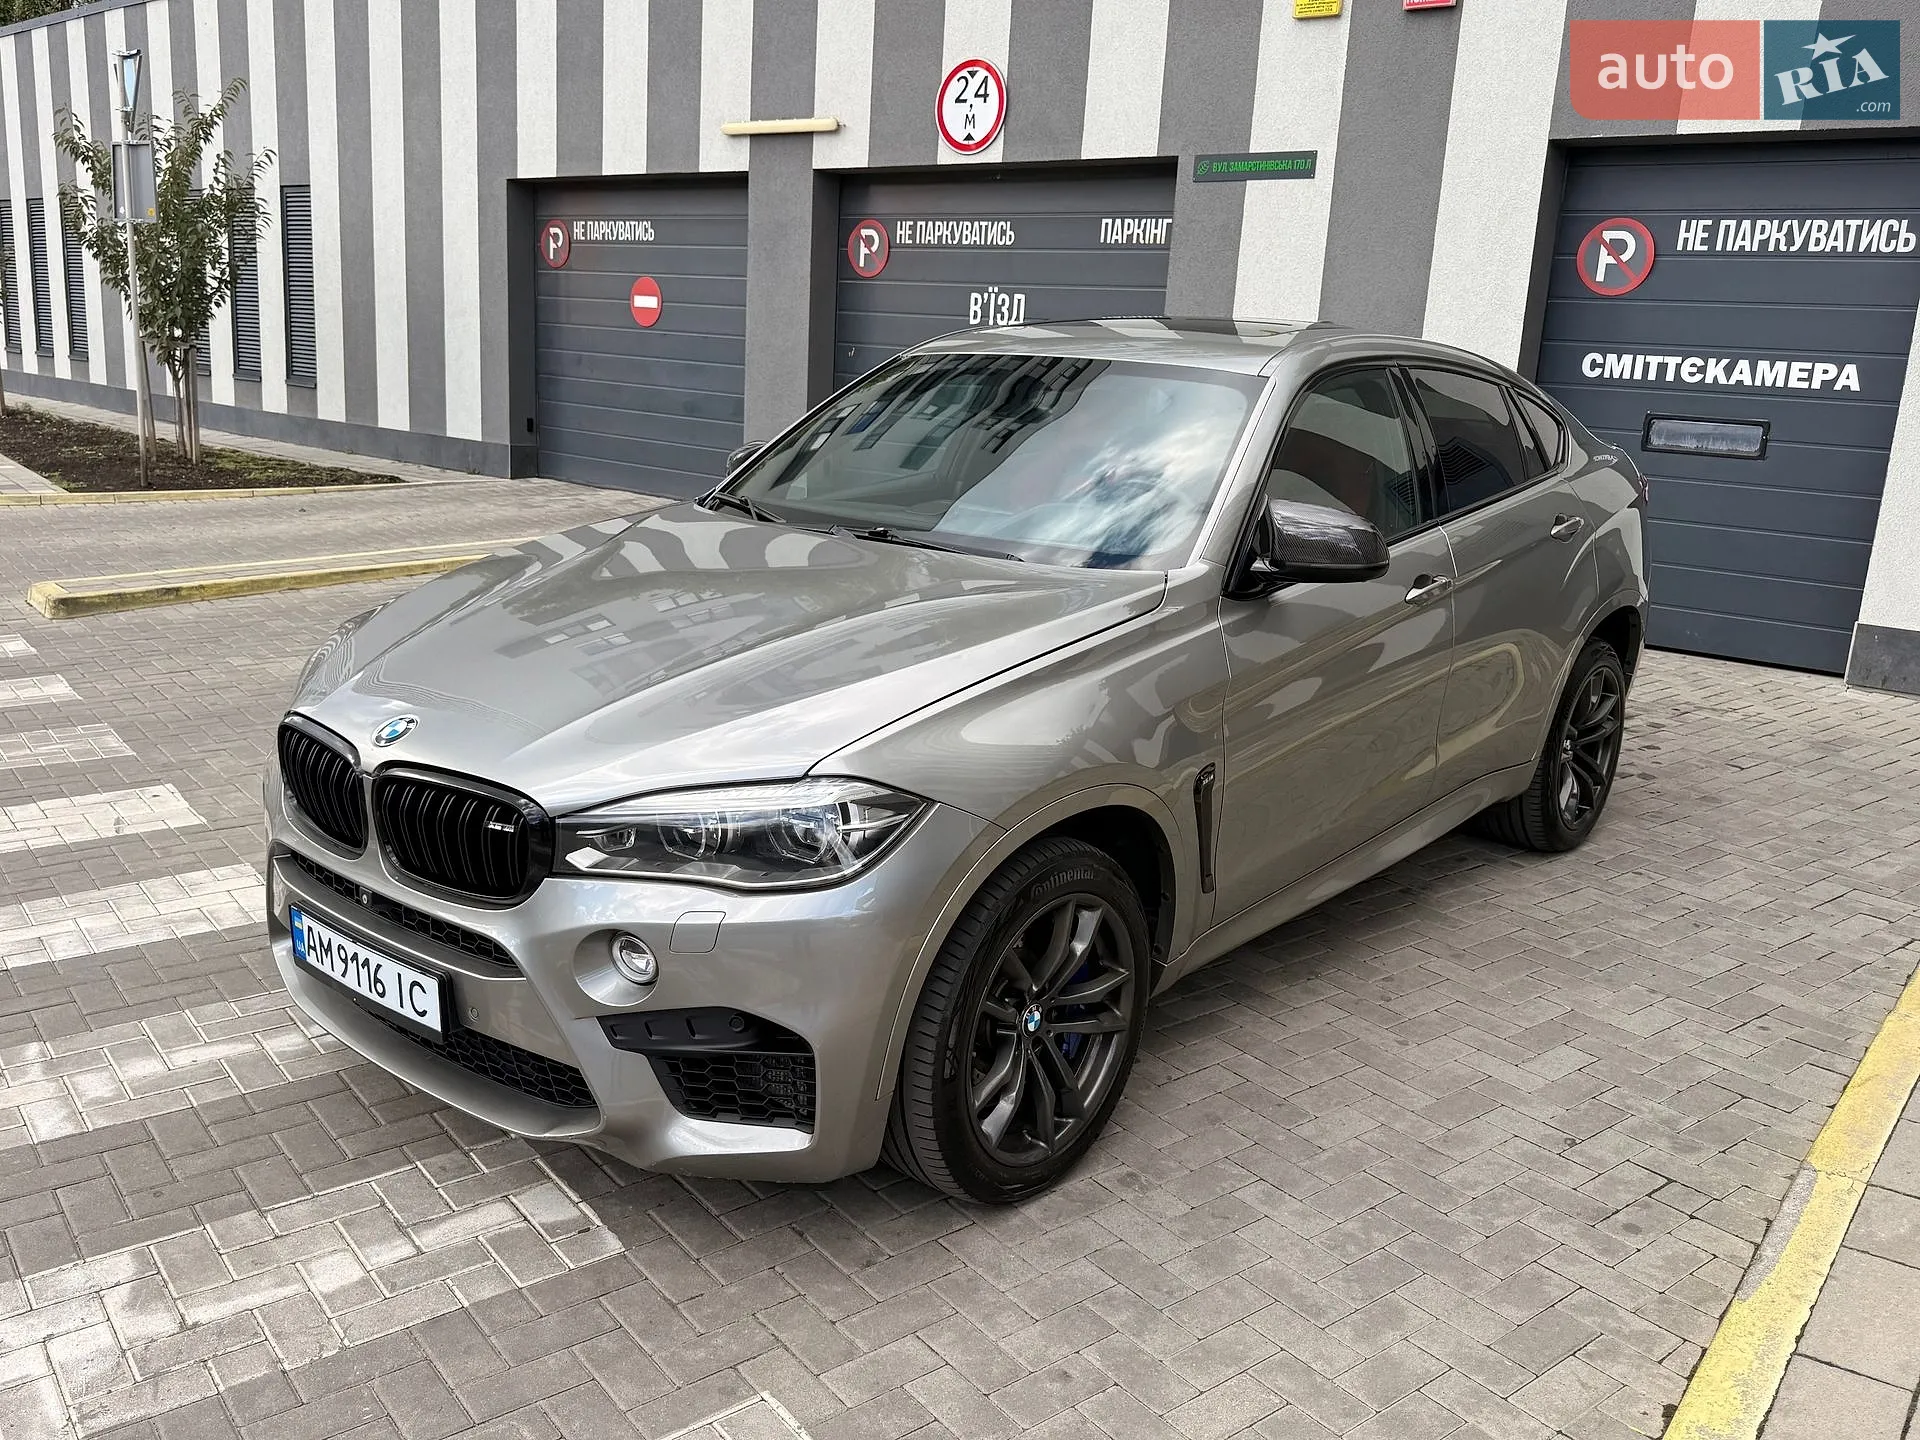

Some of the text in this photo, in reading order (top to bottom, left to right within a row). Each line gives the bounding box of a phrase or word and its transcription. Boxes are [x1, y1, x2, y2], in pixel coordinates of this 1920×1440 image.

[573, 220, 655, 242] НЕ ПАРКУВАТИСЬ
[896, 220, 1015, 246] НЕ ПАРКУВАТИСЬ
[1100, 218, 1173, 245] ПАРКІНГ
[1676, 219, 1917, 253] НЕ ПАРКУВАТИСЬ
[1581, 352, 1861, 392] СМІТТЄКАМЕРА
[397, 972, 428, 1018] IC
